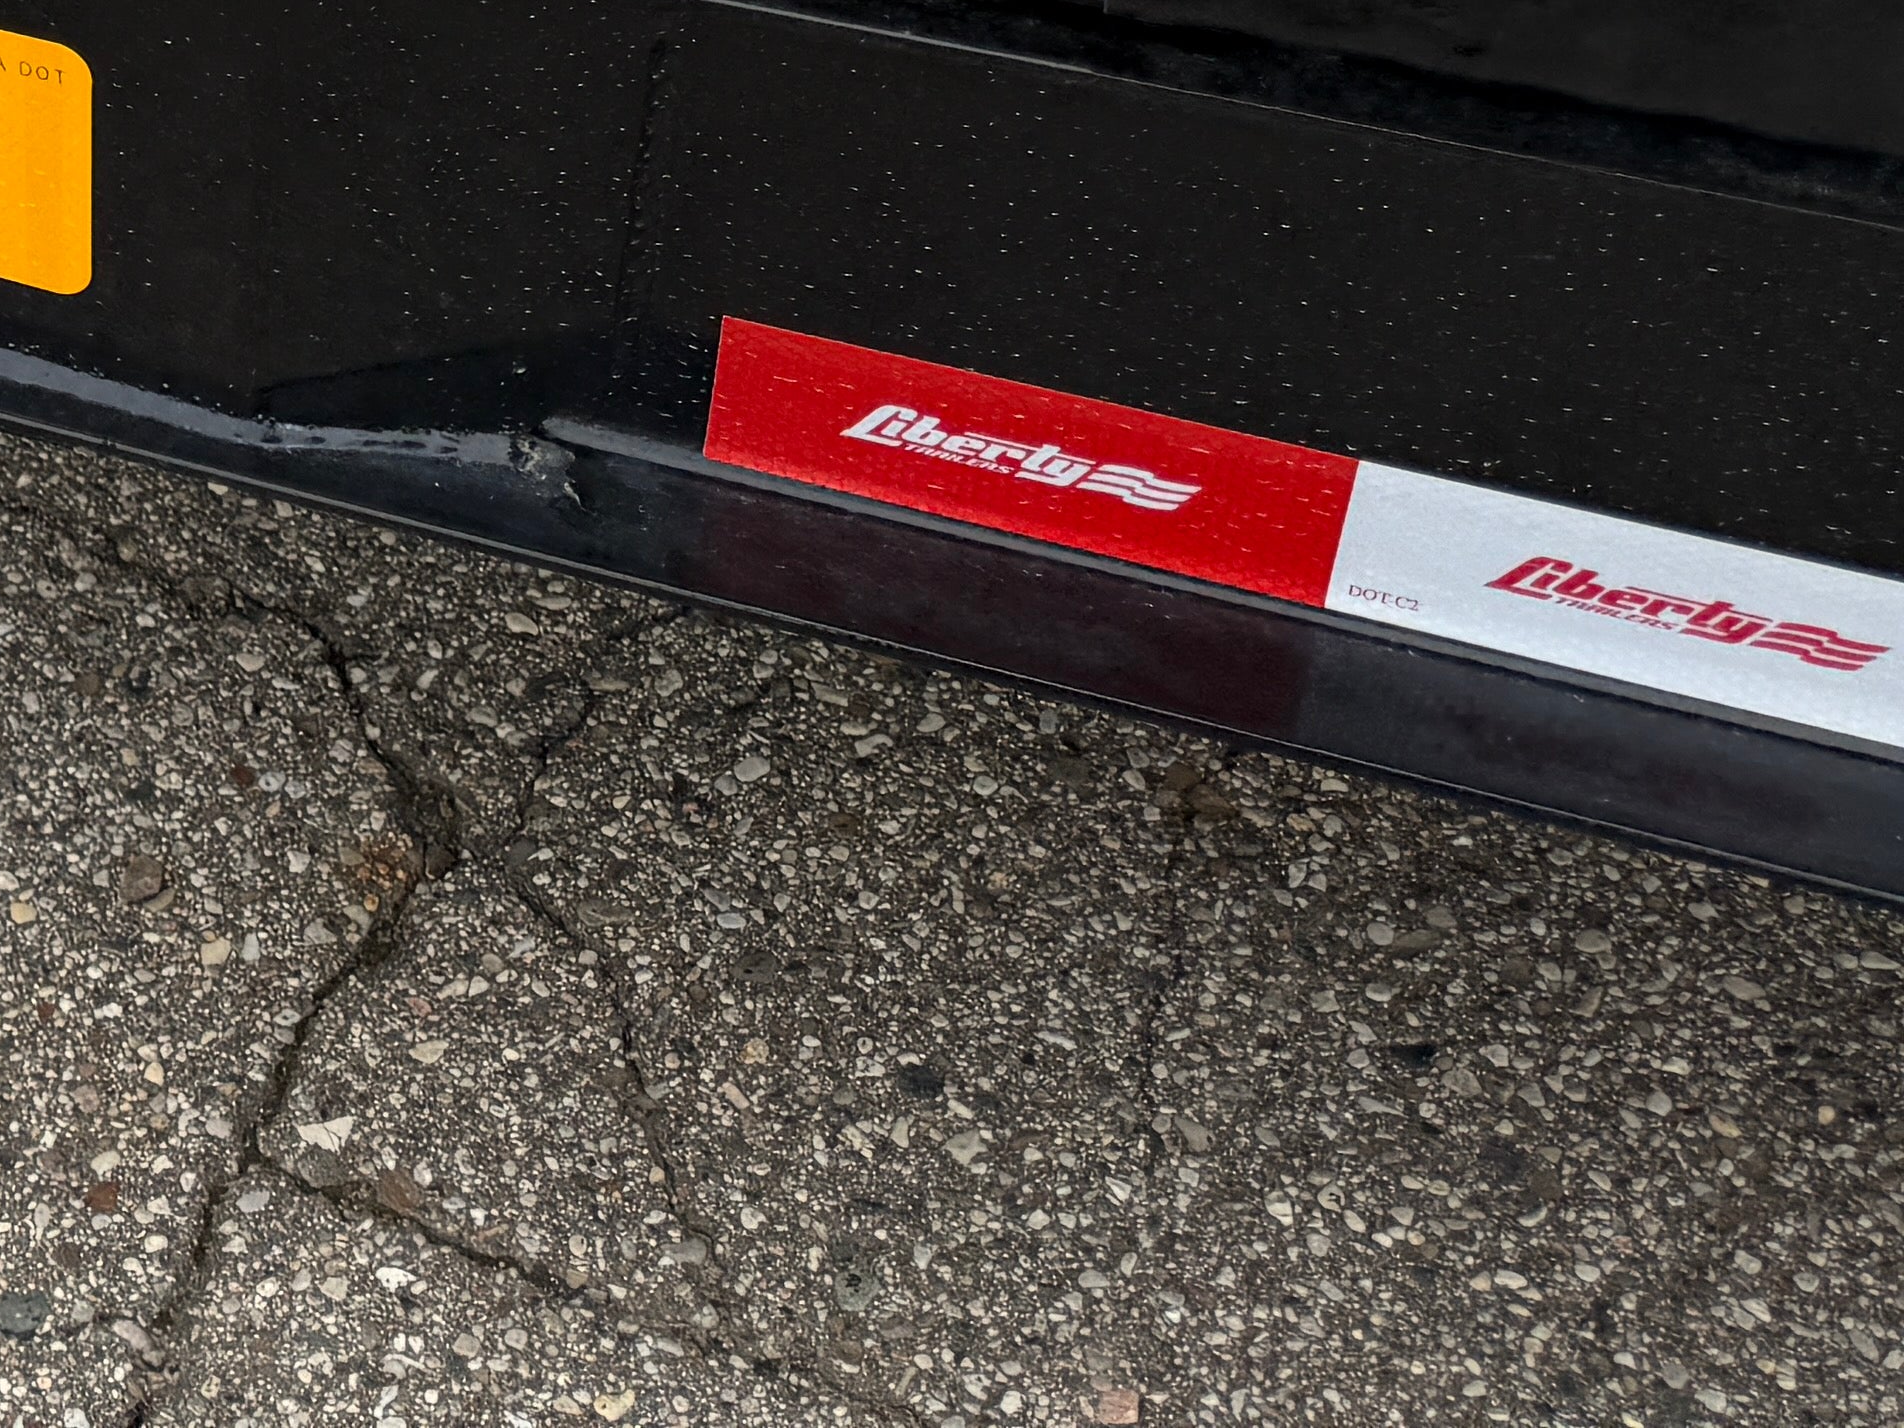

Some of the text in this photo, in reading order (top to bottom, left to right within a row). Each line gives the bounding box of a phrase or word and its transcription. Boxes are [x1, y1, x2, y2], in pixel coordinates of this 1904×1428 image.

[19, 60, 66, 85] DOT
[839, 404, 1096, 487] Liberty
[1483, 555, 1772, 645] Liberty
